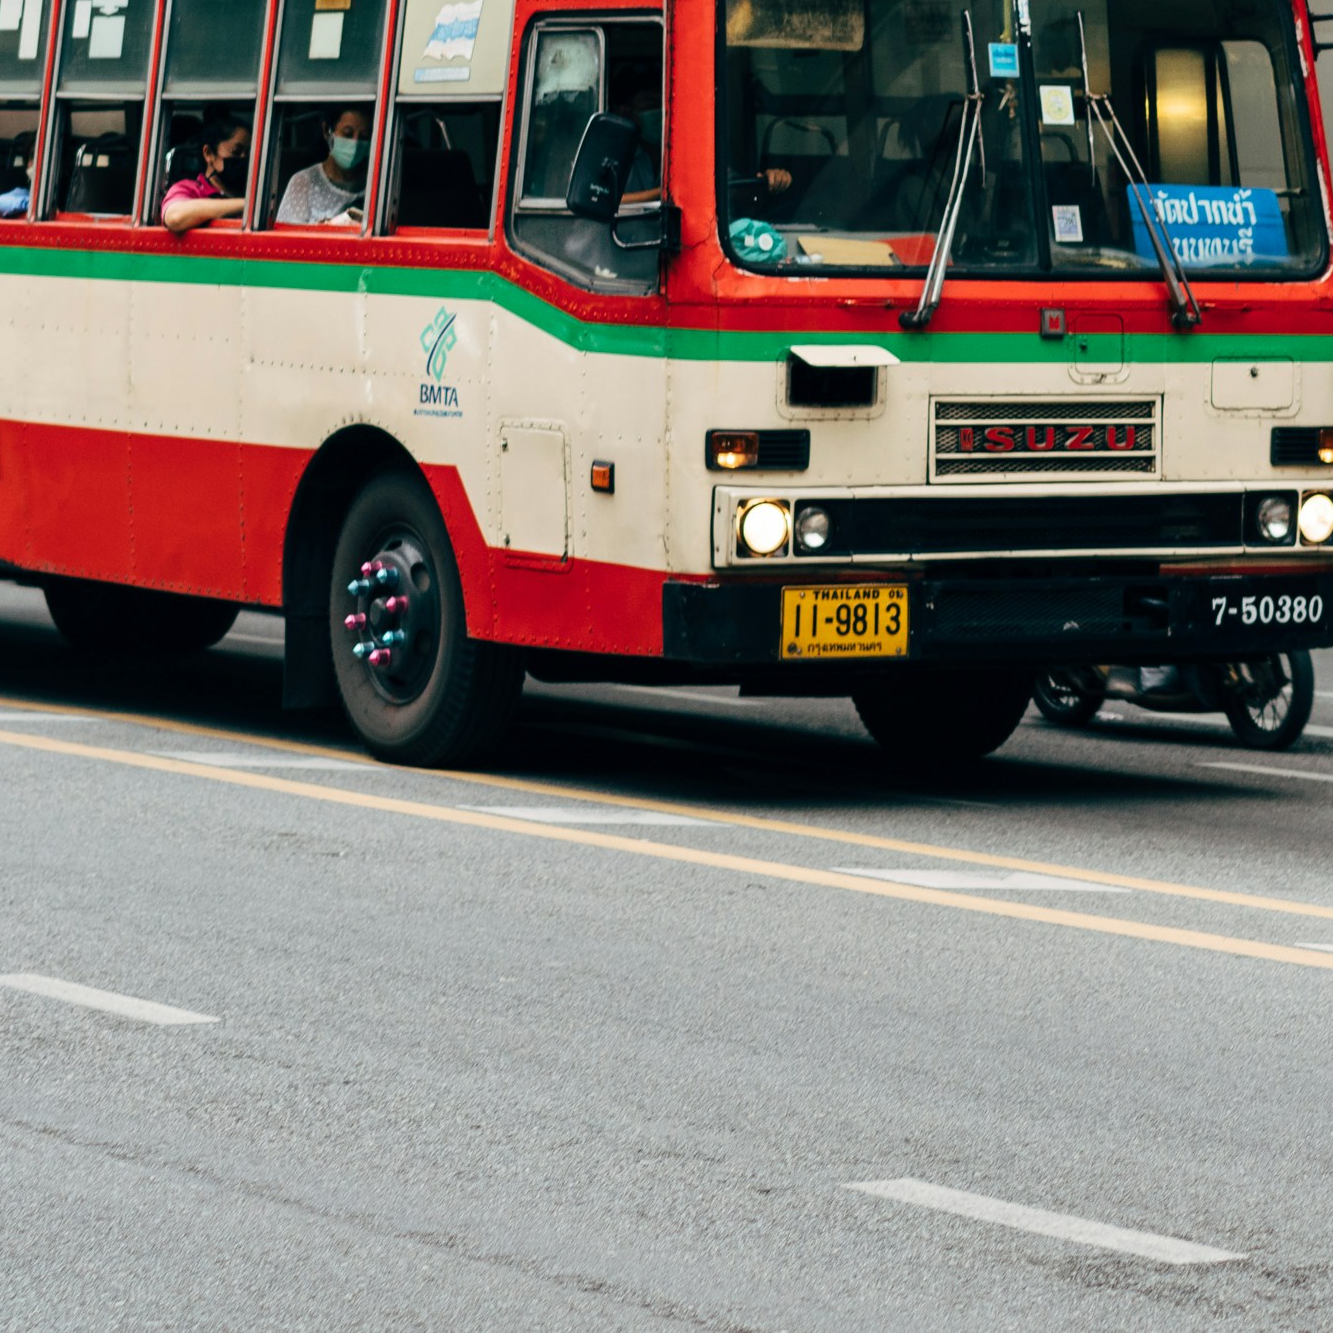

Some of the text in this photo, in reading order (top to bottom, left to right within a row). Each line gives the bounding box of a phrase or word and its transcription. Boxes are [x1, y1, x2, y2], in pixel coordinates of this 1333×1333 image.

[420, 383, 459, 408] BMTA
[959, 424, 1136, 452] ISUZU
[813, 589, 880, 601] THAILAND
[794, 602, 901, 638] 11-9813
[1212, 595, 1323, 626] 7-50380
